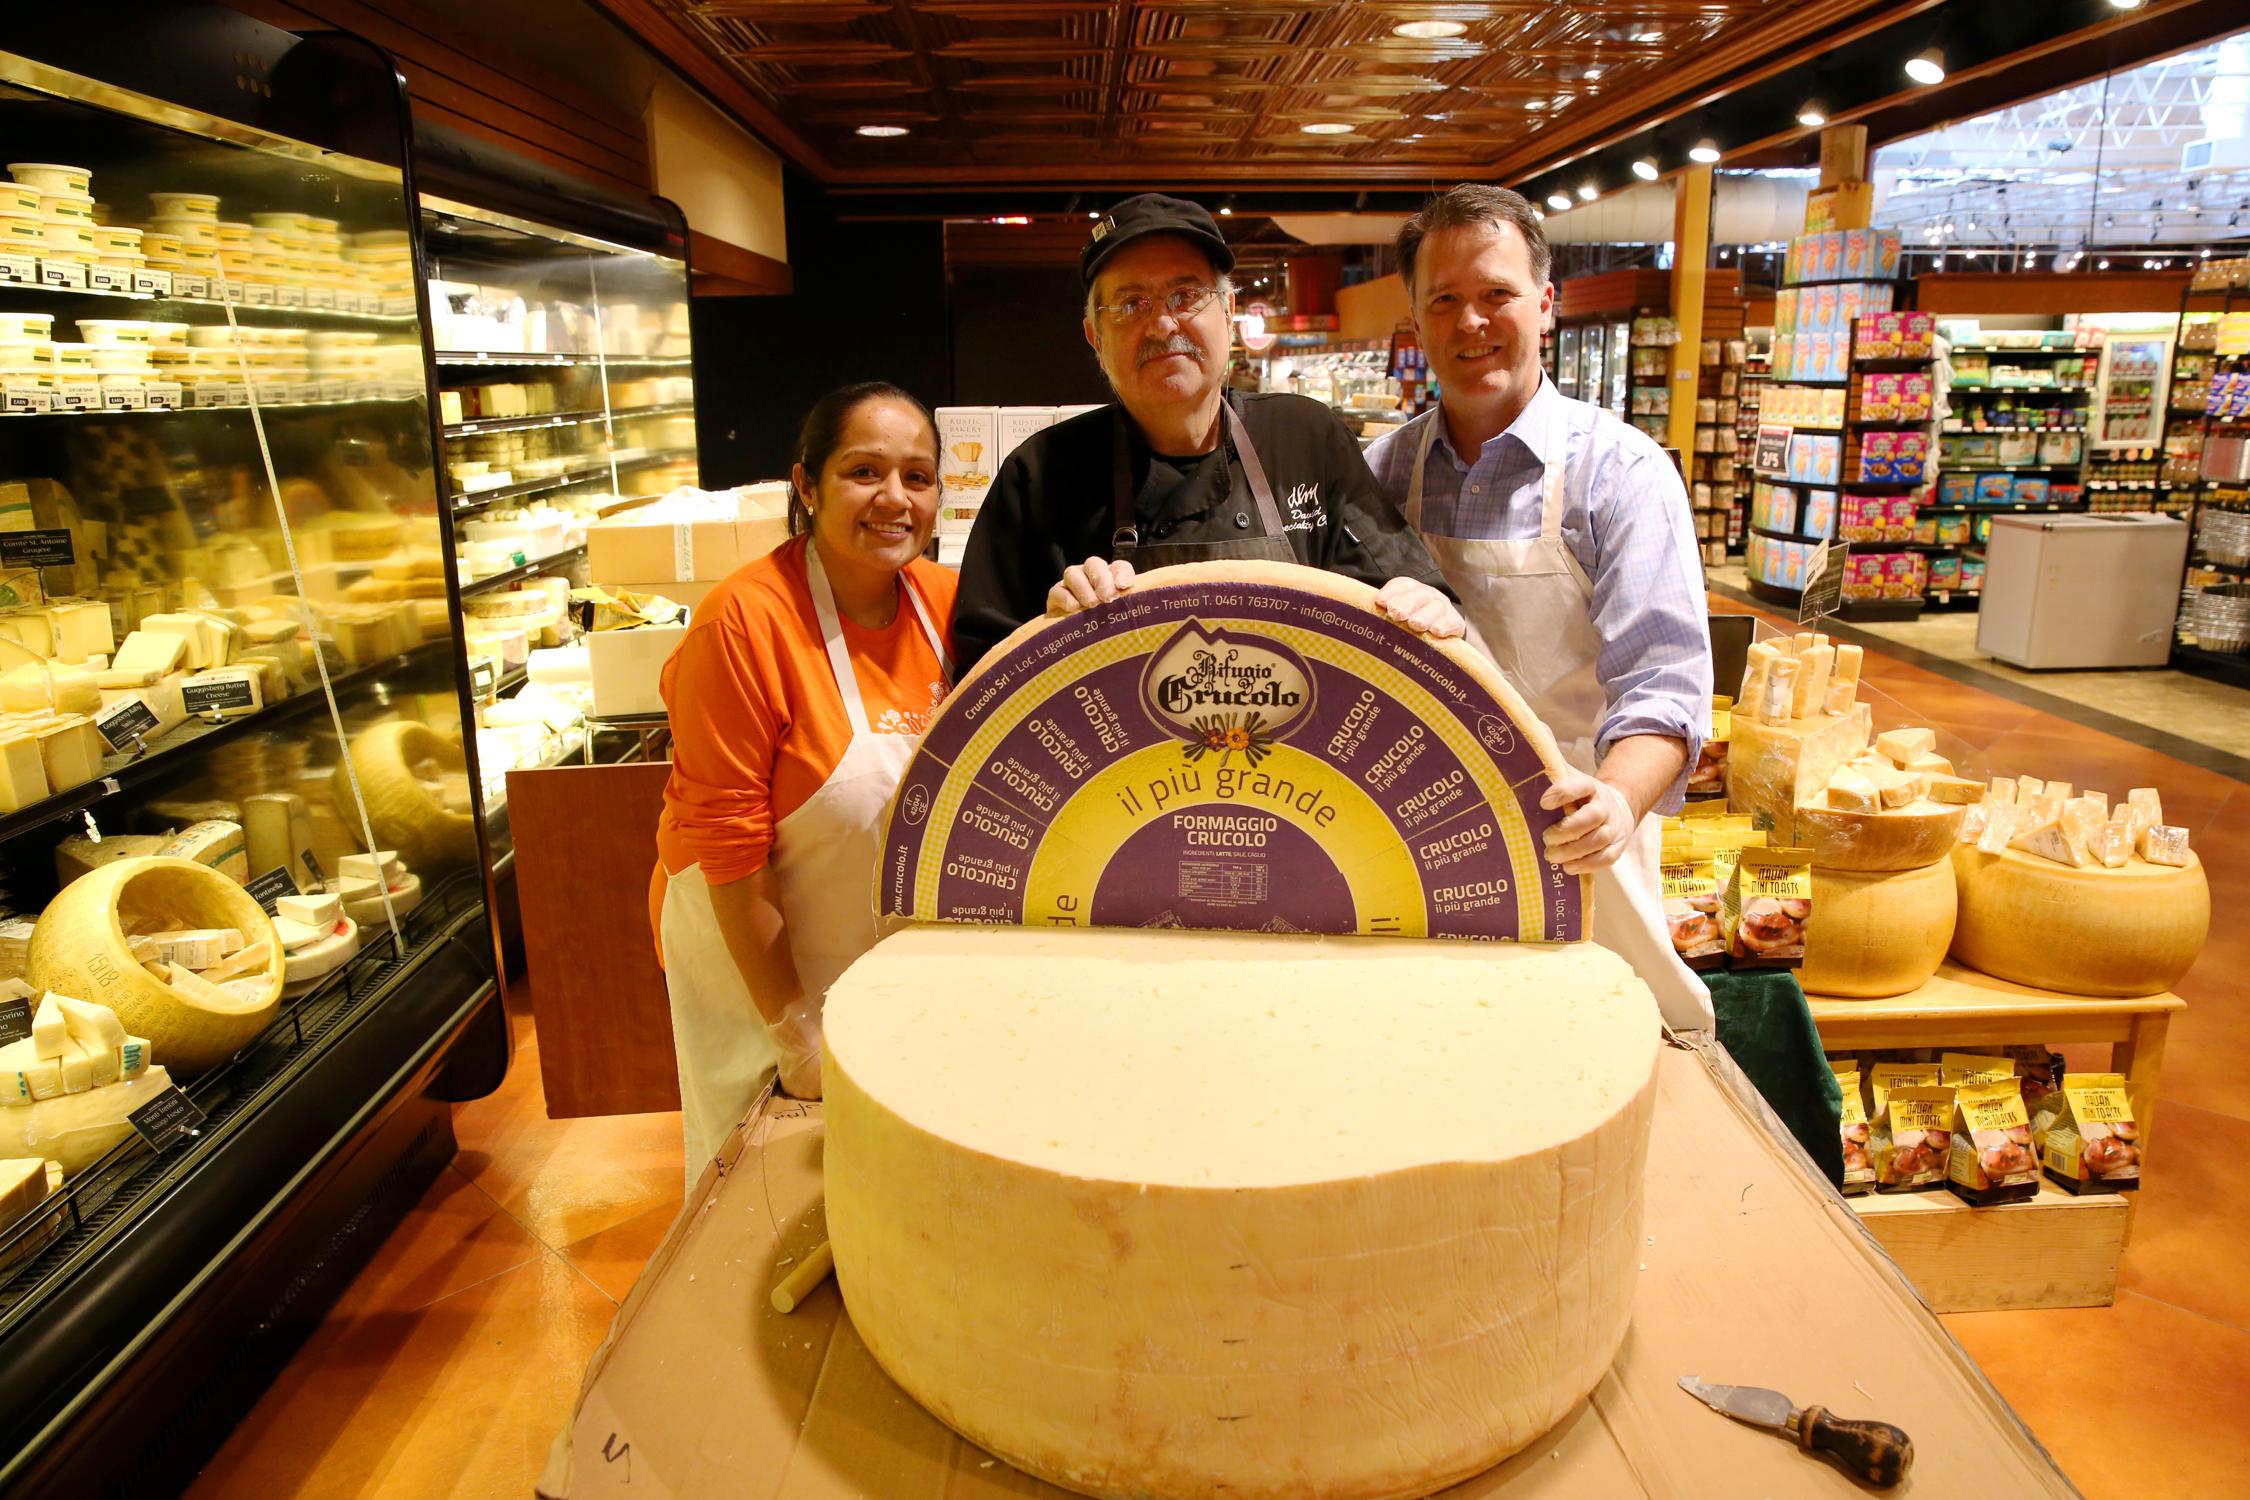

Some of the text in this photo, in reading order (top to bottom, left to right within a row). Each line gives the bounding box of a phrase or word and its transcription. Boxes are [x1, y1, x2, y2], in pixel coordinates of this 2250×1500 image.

[965, 687, 997, 721] Crucolo
[995, 673, 1011, 690] Srl
[1015, 657, 1037, 674] Loc.
[1036, 628, 1085, 659] Lagarine,
[1084, 619, 1099, 634] 20
[1107, 604, 1152, 624] Scurelle
[1161, 596, 1200, 610] Trento
[1201, 595, 1213, 606] T.
[1215, 594, 1244, 606] 0461
[1247, 596, 1290, 611] 763707
[1300, 603, 1385, 646] info@crucolo.it
[1393, 644, 1467, 702] www.crucolo.it
[1193, 649, 1272, 688] Rifugio
[205, 691, 230, 700] Cheese
[225, 682, 247, 692] Butter
[1158, 670, 1301, 714] Crucolo
[1093, 688, 1118, 722] grande
[1074, 686, 1120, 753] CRUCOLO
[1112, 722, 1128, 738] più
[1327, 689, 1375, 756] CRUCOLO
[1046, 718, 1092, 771] il più grande
[1339, 705, 1381, 763] il più grande
[1028, 720, 1083, 779] CRUCOLO
[1364, 725, 1424, 784] CRUCOLO
[1007, 757, 1061, 802] il più grande
[1374, 743, 1427, 793] il più grande
[991, 761, 1054, 812] CRUCOLO
[1116, 763, 1337, 828] il più grande
[1396, 769, 1464, 819] CRUCOLO
[976, 803, 1034, 838] il più grande
[1404, 788, 1464, 829] il più grande
[962, 810, 1029, 850] CRUCOLO
[1173, 815, 1278, 832] FORMAGGIO
[1187, 830, 1267, 847] CRUCOLO
[1419, 823, 1493, 860] CRUCOLO
[958, 854, 1019, 877] il più grande
[1423, 841, 1488, 871] il più grande
[947, 863, 1017, 890] CRUCOLO
[1552, 872, 1565, 888] Srl
[1665, 868, 1694, 881] ITALIAN
[1678, 880, 1706, 893] TOASTS
[1758, 868, 1789, 881] ITALIAN
[1433, 879, 1509, 903] CRUCOLO
[1751, 881, 1799, 895] MINI TOASTS
[952, 906, 987, 915] grande
[1435, 895, 1501, 914] il più grande
[1555, 899, 1566, 921] Loc.
[1962, 1073, 1993, 1085] ITALIAN
[1906, 1103, 1933, 1115] ITALIAN
[1977, 1102, 2004, 1115] ITALIAN
[2084, 1095, 2111, 1106] ITALIAN
[1900, 1114, 1941, 1128] MINI TOASTS
[1974, 1111, 2018, 1126] MINI TOASTS
[2096, 1107, 2122, 1119] TOASTS
